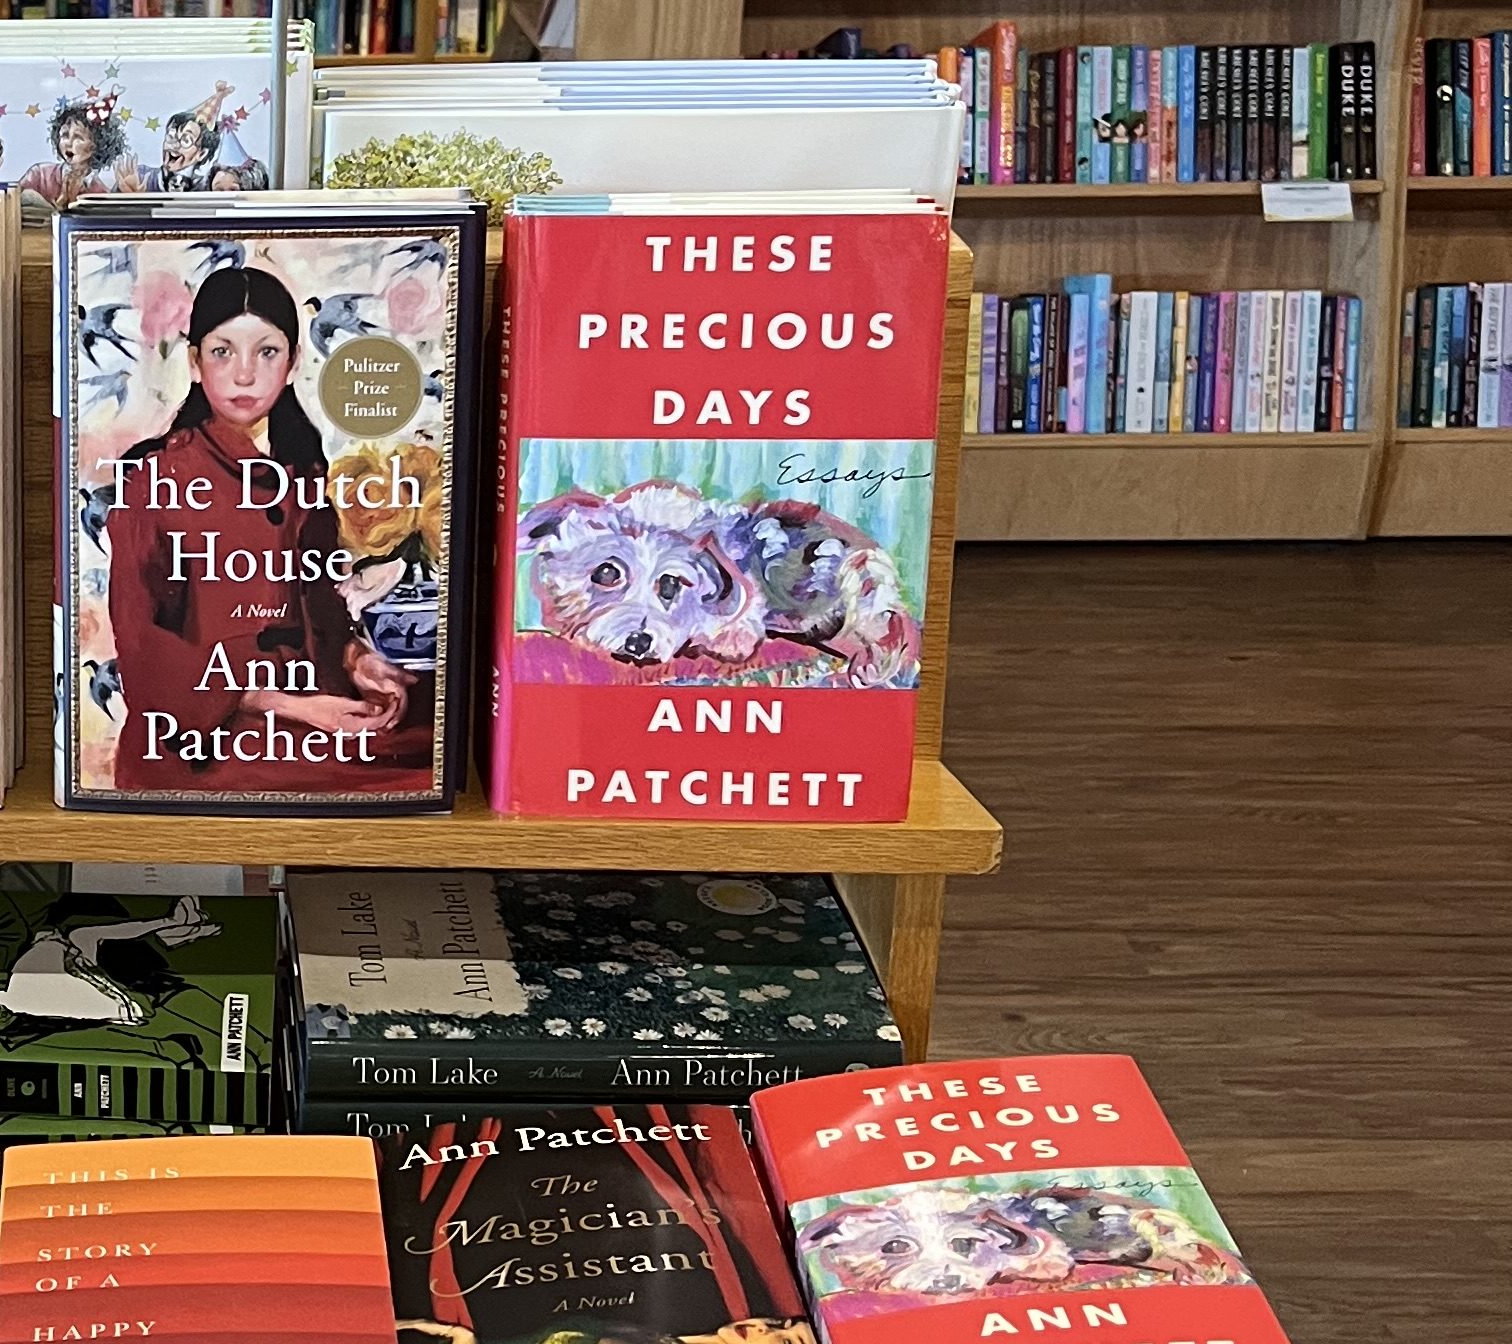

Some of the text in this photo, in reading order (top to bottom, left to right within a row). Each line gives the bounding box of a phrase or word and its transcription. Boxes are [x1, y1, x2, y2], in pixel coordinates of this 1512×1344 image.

[1341, 64, 1355, 117] DUKE
[1359, 64, 1374, 117] DUKE
[645, 235, 835, 273] THESE
[578, 312, 896, 350] PRECIOUS
[343, 357, 401, 376] Pulitzer
[353, 380, 390, 397] Prize
[653, 388, 813, 426] DAYS
[343, 402, 398, 418] Finalist
[95, 458, 423, 510] The Dutch
[777, 452, 934, 499] Essays
[167, 531, 354, 582] House
[230, 602, 287, 619] A Novel
[193, 641, 319, 692] Ann
[648, 698, 784, 734] ANN
[141, 711, 377, 763] Patchett
[566, 769, 864, 808] PATCHETT
[226, 997, 245, 1062] ANN PATCHETT
[352, 1058, 805, 1088] Tom Lake Ann Patchett
[863, 1074, 1044, 1107] THESE
[397, 1118, 713, 1170] Ann Patchett
[815, 1102, 1122, 1149] PRECIOUS
[902, 1138, 1061, 1171] DAYS
[42, 1166, 181, 1185] THIS IS
[530, 1174, 599, 1197] The
[39, 1202, 113, 1218] THE
[404, 1202, 722, 1256] Magician's
[36, 1241, 159, 1263] STORY
[34, 1273, 121, 1293] OF A
[429, 1249, 716, 1298] Assistant
[552, 1292, 636, 1312] A Novel
[979, 1302, 1129, 1337] ANN
[32, 1320, 157, 1343] HAPPY
